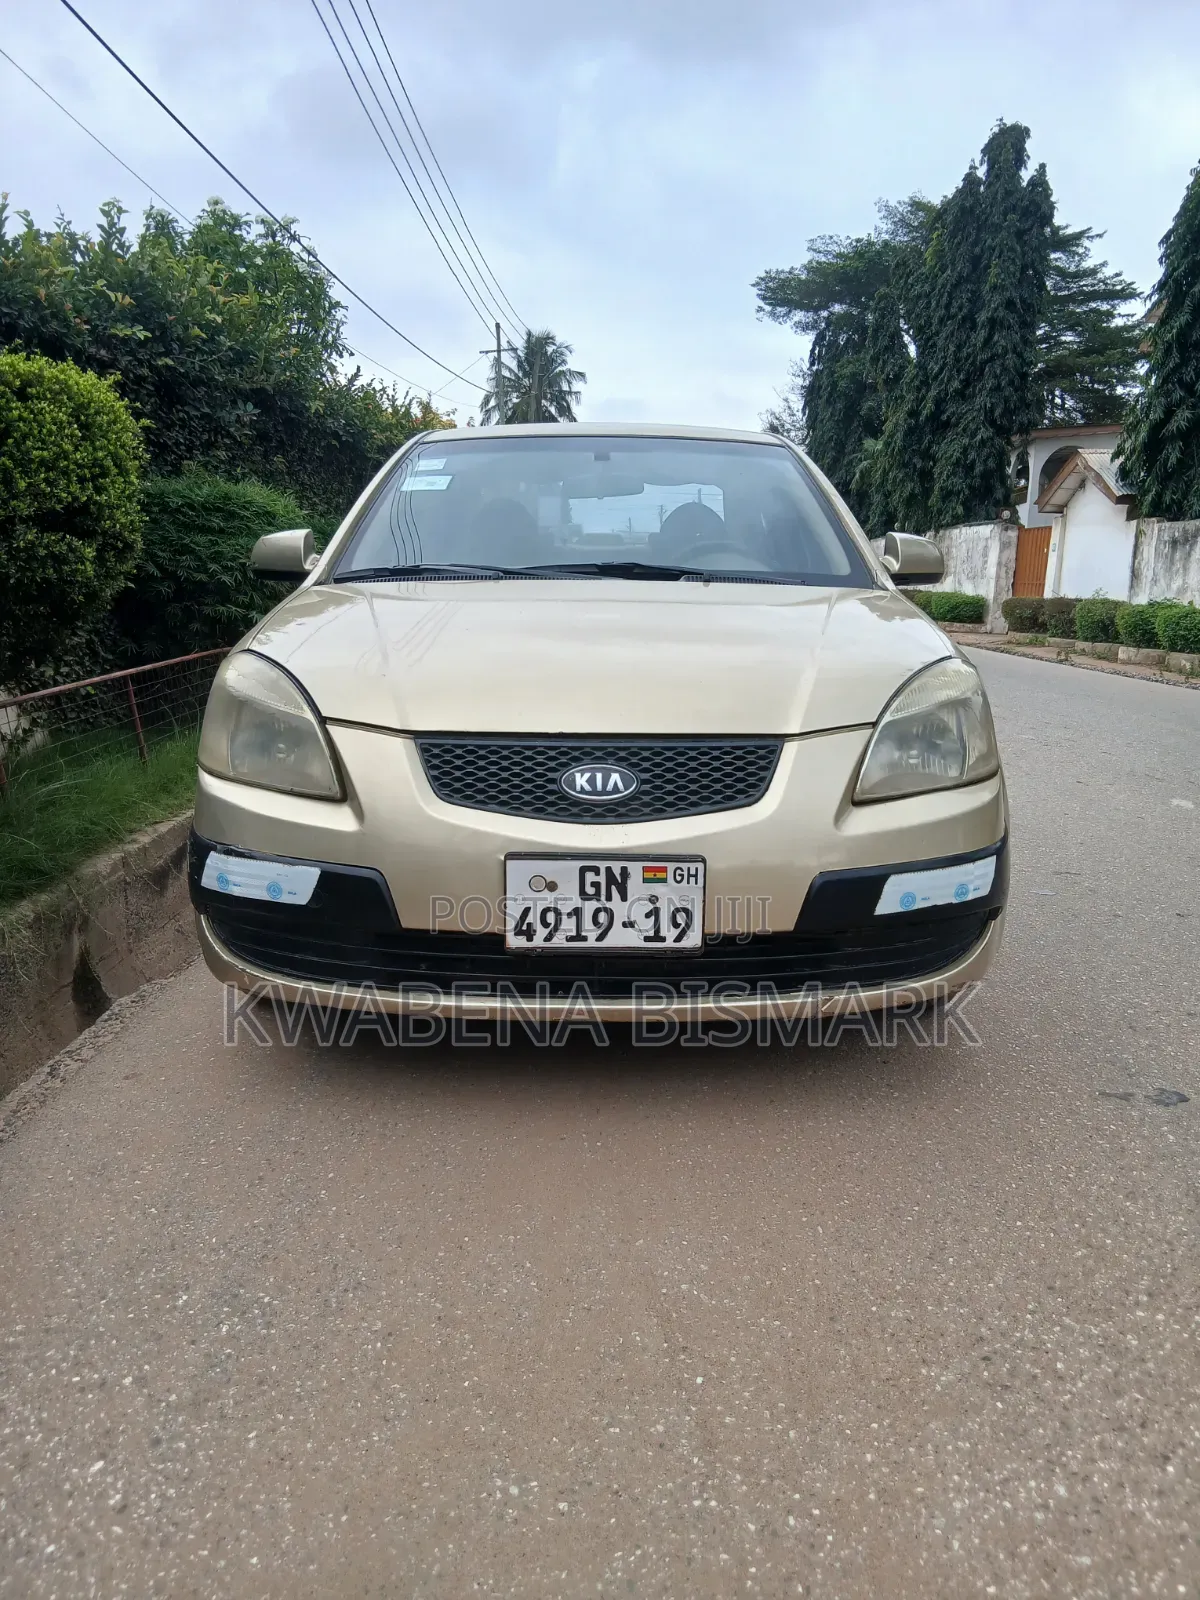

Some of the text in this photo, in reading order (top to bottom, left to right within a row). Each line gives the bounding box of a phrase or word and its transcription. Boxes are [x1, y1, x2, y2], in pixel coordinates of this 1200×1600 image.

[574, 772, 625, 792] KIA
[578, 865, 629, 902] GN
[672, 866, 699, 885] GH
[513, 906, 694, 943] 4919-19
